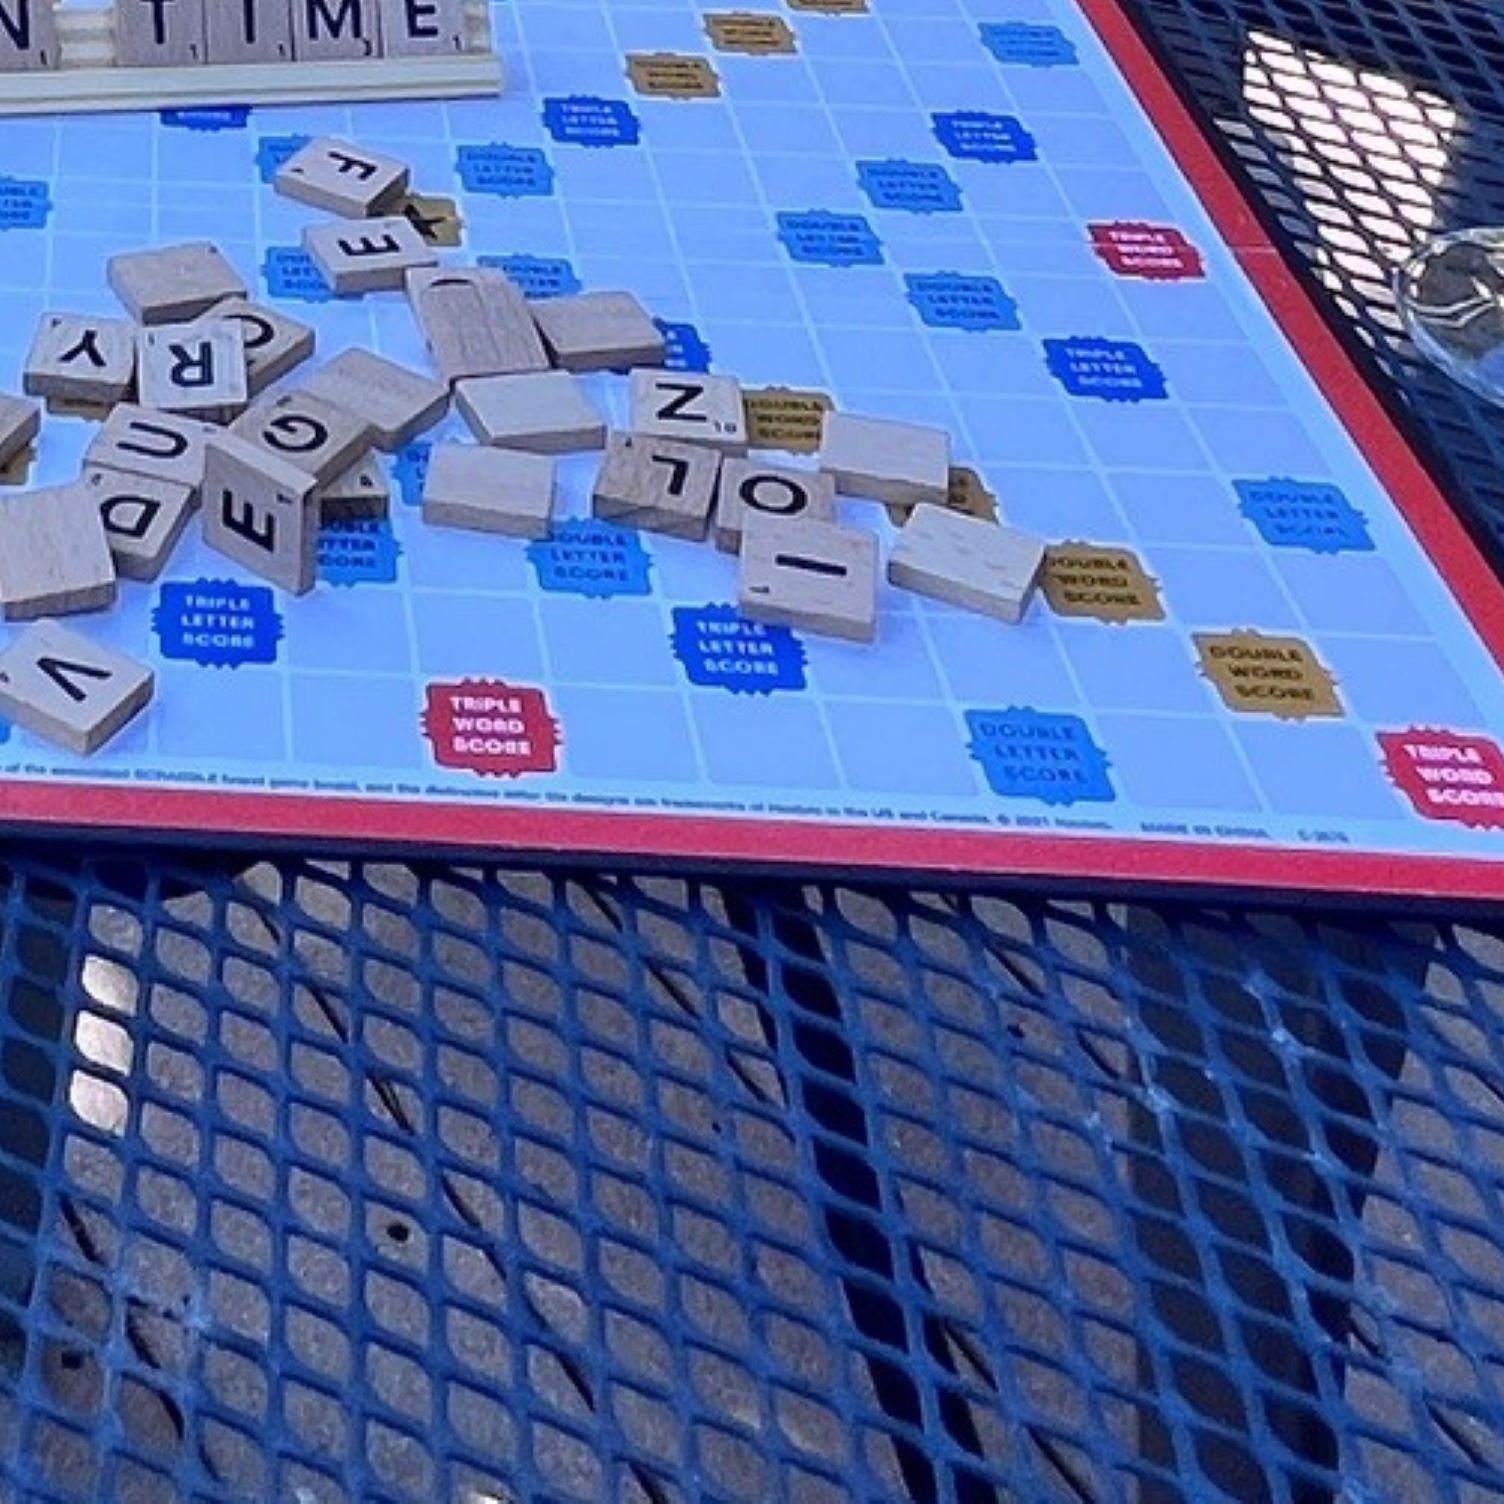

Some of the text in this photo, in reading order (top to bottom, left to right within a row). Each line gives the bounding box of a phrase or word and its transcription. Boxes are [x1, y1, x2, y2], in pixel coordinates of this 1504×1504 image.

[327, 150, 377, 180] F
[338, 233, 402, 256] E
[58, 329, 107, 367] Y
[168, 341, 215, 387] R
[655, 382, 708, 423] Z
[116, 422, 189, 459] U
[263, 413, 329, 454] G
[739, 475, 808, 516] O
[100, 494, 162, 539] D
[222, 488, 275, 553] E
[183, 595, 251, 612] TRIPLE
[180, 614, 254, 631] LETTER
[696, 620, 767, 637] TRIPLE
[181, 633, 255, 648] SCORE
[699, 640, 775, 657] LETTER
[1209, 645, 1304, 663] DOUBLE
[703, 659, 779, 677] SCORE
[1228, 664, 1304, 681] WORD
[1235, 684, 1314, 702] SCORE
[449, 695, 523, 714] TRIPLE
[451, 717, 525, 734] WORD
[979, 722, 1075, 740] DOUBLE
[451, 736, 532, 756] SCORE
[993, 744, 1081, 761] LETTER
[1404, 743, 1481, 764] TRIPLE
[1002, 764, 1088, 784] SCORE
[1417, 766, 1494, 786] WORD
